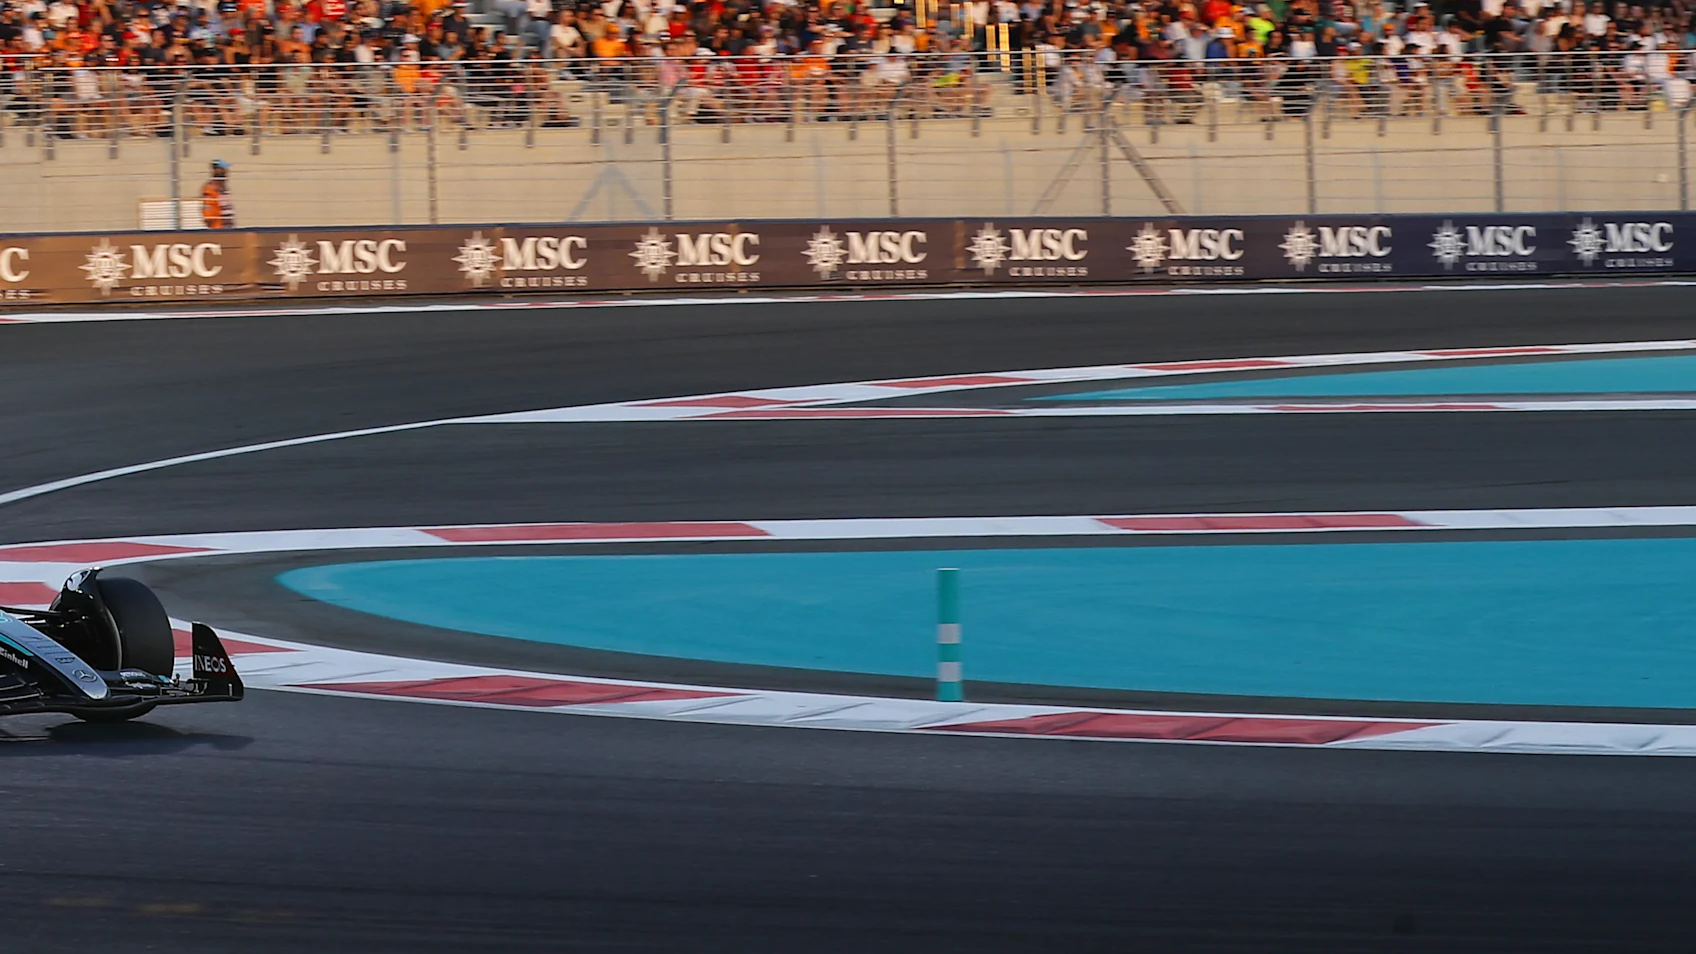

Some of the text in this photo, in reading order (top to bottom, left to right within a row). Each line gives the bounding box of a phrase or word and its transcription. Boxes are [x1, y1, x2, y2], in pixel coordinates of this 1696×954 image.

[675, 233, 760, 267] MSC
[845, 231, 927, 264] MSC
[1008, 228, 1088, 261] MSC
[1167, 229, 1244, 260] MSC
[1318, 226, 1392, 257] MSC
[1465, 226, 1537, 256] MSC
[1604, 222, 1674, 252] MSC
[129, 243, 223, 279] MSC
[316, 239, 407, 274] MSC
[500, 236, 587, 271] MSC
[316, 280, 408, 292] CRUISES
[500, 276, 588, 287] CRUISES
[675, 272, 761, 283] CRUISES
[845, 269, 928, 280] CRUISES
[1008, 266, 1088, 277] CRUISES
[1167, 266, 1244, 276] CRUISES
[129, 285, 224, 297] CRUISES
[194, 654, 226, 673] INEOS
